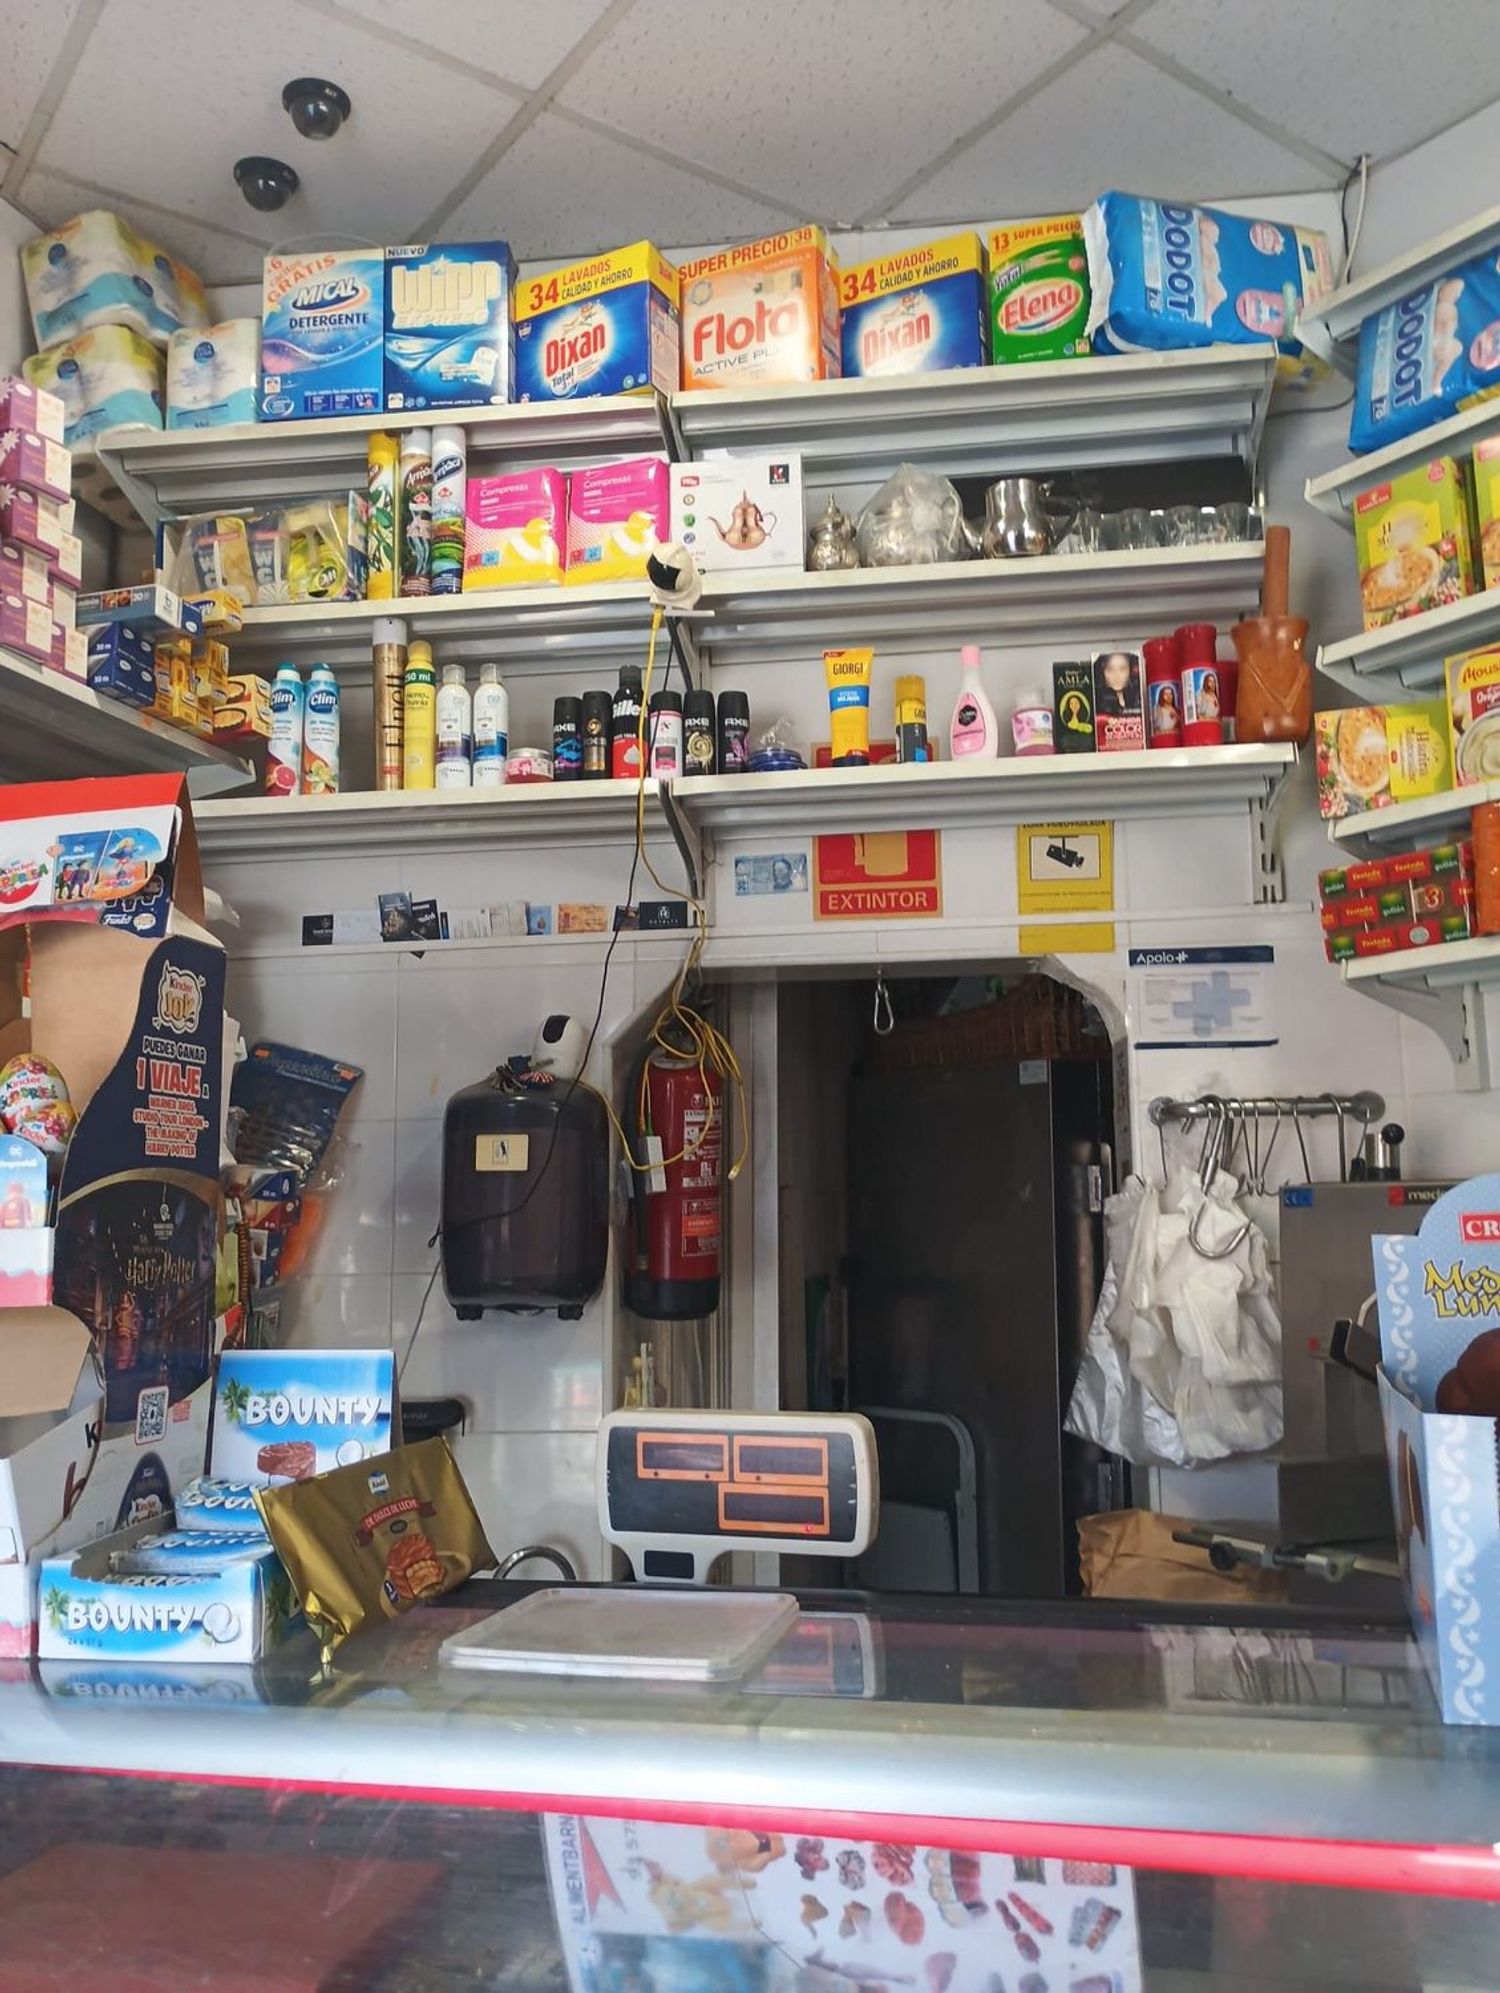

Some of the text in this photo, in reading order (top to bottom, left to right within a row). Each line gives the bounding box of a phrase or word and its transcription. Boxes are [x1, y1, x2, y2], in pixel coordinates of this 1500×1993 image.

[1013, 226, 1044, 241] SUPER
[387, 247, 425, 257] NUEVO
[678, 254, 728, 282] SUPER
[732, 234, 789, 266] PRECIO
[1160, 203, 1197, 320] DODOT
[267, 254, 337, 304] GRATIS
[529, 259, 611, 311] 34 LAVADOS
[561, 267, 633, 300] CALIDAD Y AHORRO
[843, 248, 934, 302] 34 LAVADOS
[879, 256, 959, 290] CALIDAD Y AHORRO
[296, 277, 357, 307] MICAL
[1003, 283, 1073, 331] Elena
[289, 312, 369, 329] DETERGENTE
[693, 299, 799, 363] Flota
[545, 323, 606, 378] Dixan
[863, 313, 931, 369] Dixan
[694, 352, 748, 376] ACTIVE
[480, 483, 528, 498] Compresas
[583, 476, 632, 489] Compresas
[418, 671, 431, 682] ml
[833, 662, 864, 676] GIORGI
[1057, 674, 1090, 686] AMLA
[684, 717, 710, 728] AXE
[724, 717, 750, 728] AXE
[827, 891, 928, 911] EXTINTOR
[1136, 951, 1175, 967] Apolo
[143, 1036, 206, 1064] PUEDES GANAR
[136, 1057, 146, 1090] 1
[150, 1059, 201, 1098] VIAJE
[245, 1393, 384, 1427] BOUNTY
[66, 1601, 197, 1633] BOUNTY
